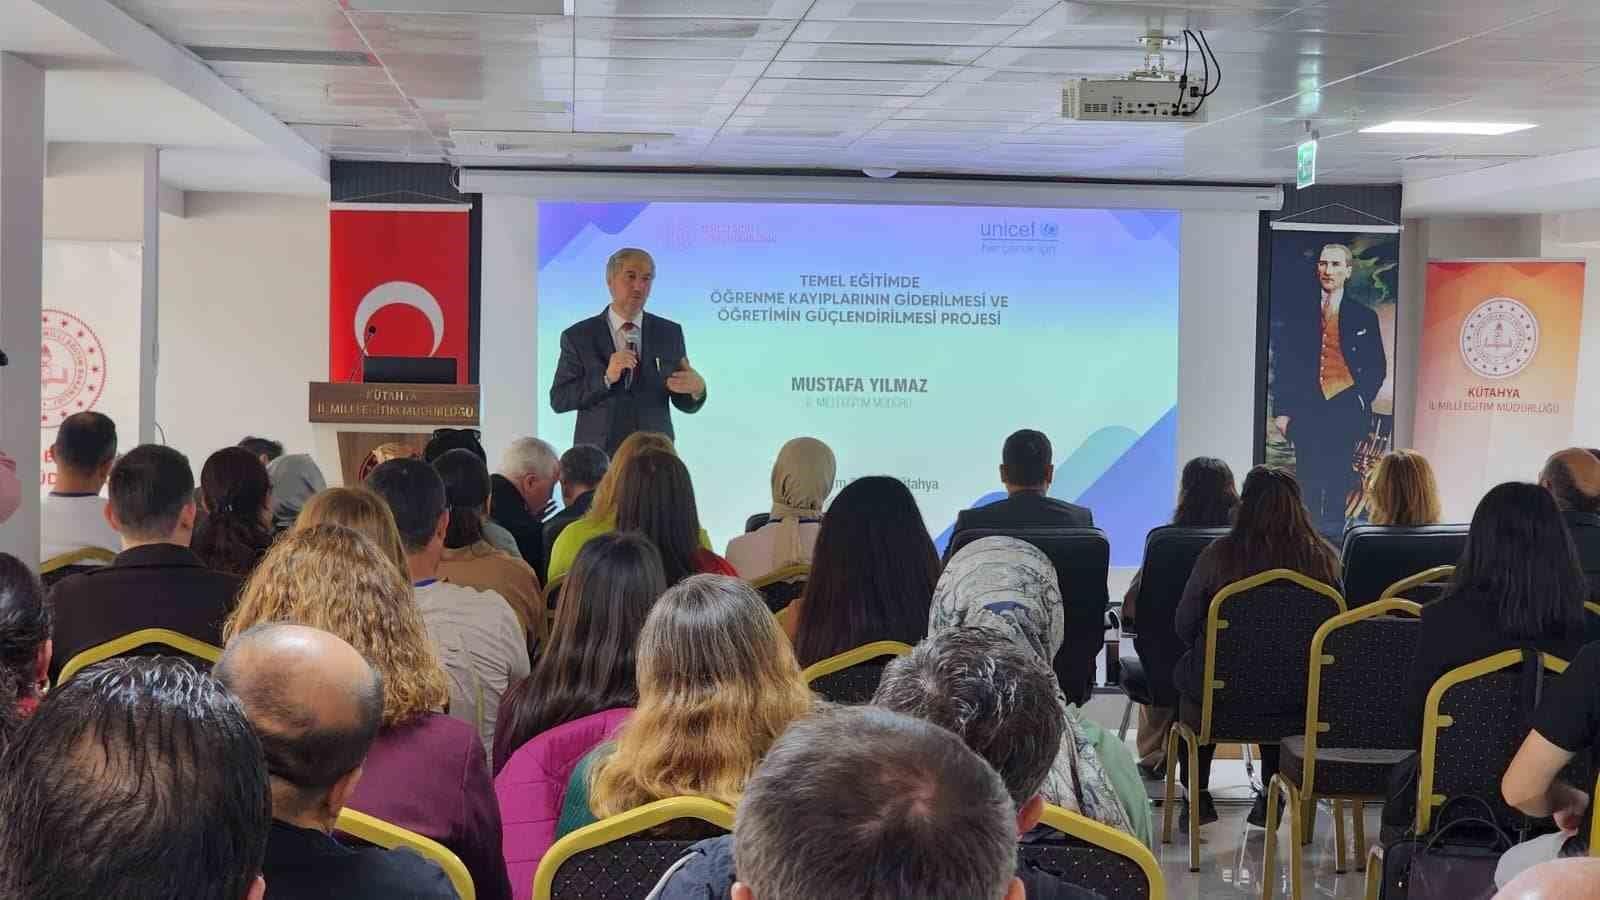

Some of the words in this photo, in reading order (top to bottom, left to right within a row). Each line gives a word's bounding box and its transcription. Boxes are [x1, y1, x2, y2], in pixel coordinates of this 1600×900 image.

[980, 218, 1036, 237] unicef
[800, 274, 846, 287] TEMEL
[850, 272, 921, 288] EĞİTİMDE
[710, 288, 785, 304] ÖĞRENME
[789, 292, 890, 305] KAYIPLARININ
[894, 291, 987, 308] GİDERİLMESİ
[990, 296, 1009, 308] VE
[717, 306, 801, 322] ÖĞRETİMİN
[804, 308, 937, 326] GÜÇLENDİRİLMESİ
[941, 311, 1001, 326] PROJESİ
[791, 376, 865, 392] MUSTAFA
[869, 377, 929, 393] YILMAZ
[1467, 385, 1520, 399] KÜTAHYA
